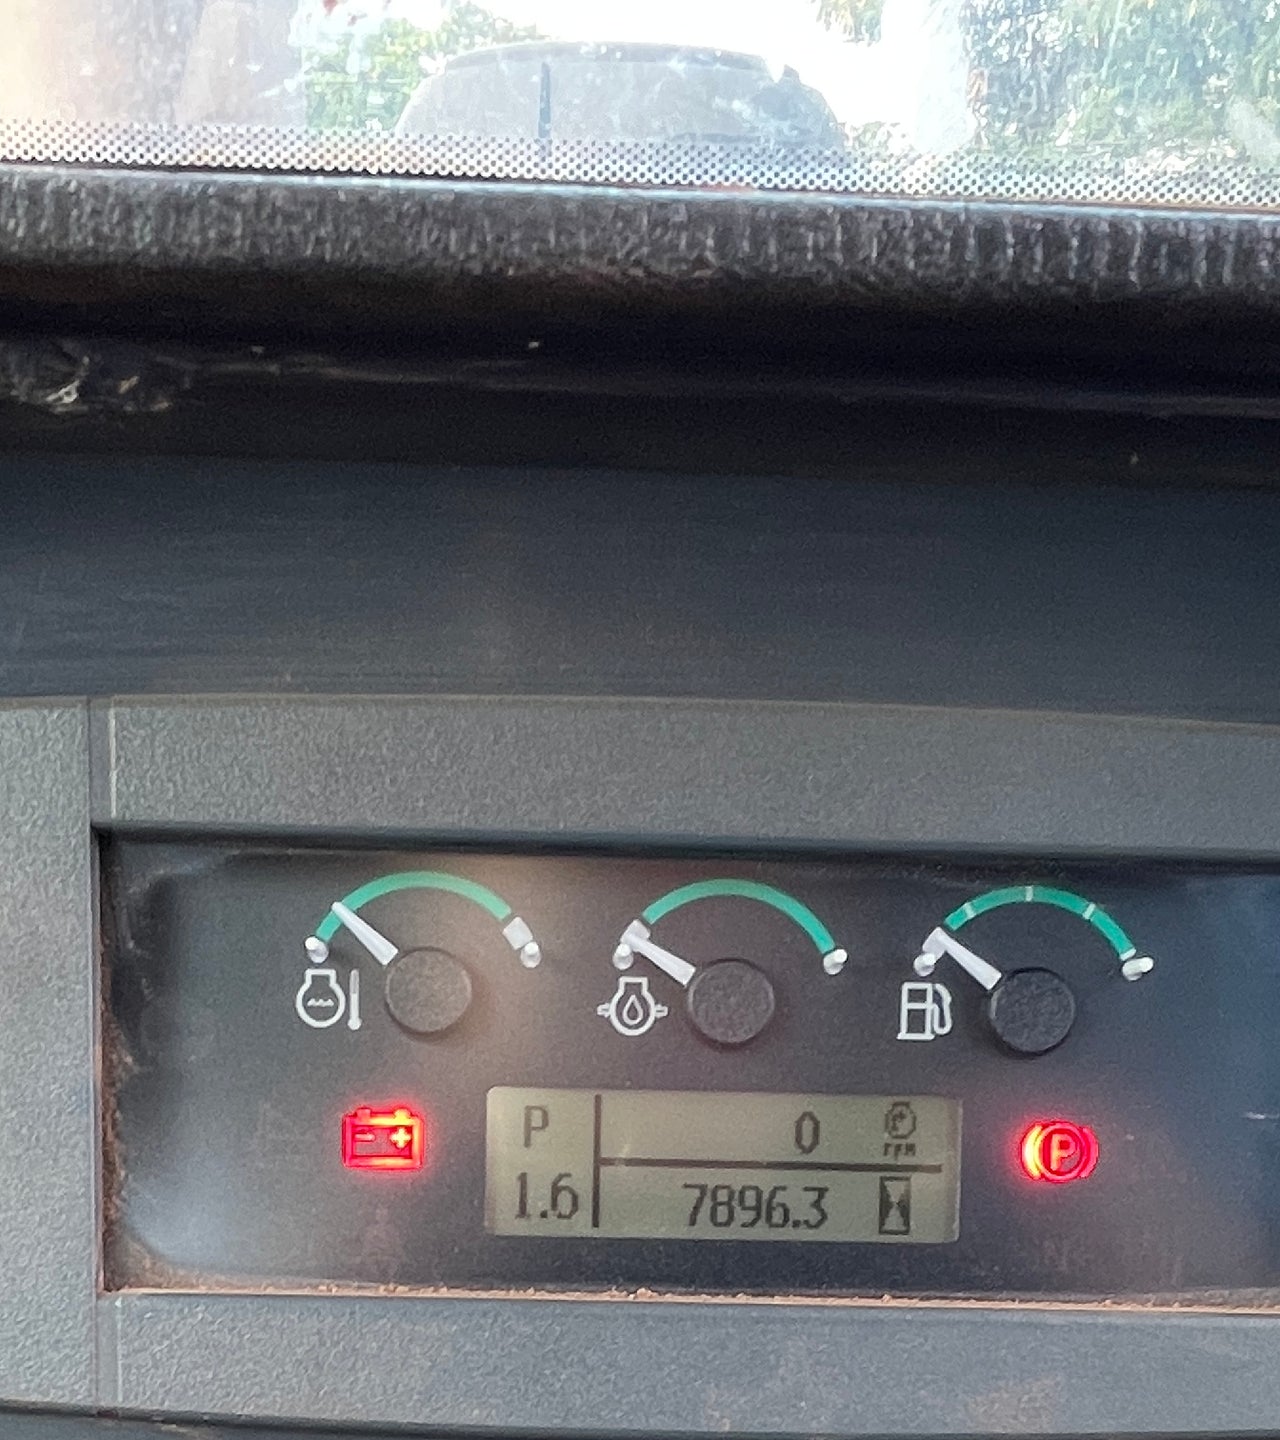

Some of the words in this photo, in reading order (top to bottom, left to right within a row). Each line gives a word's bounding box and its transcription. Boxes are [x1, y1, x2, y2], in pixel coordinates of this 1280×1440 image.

[524, 1105, 550, 1148] P
[794, 1111, 820, 1154] 0
[515, 1171, 579, 1220] 1.6
[681, 1181, 829, 1230] 7896.3
